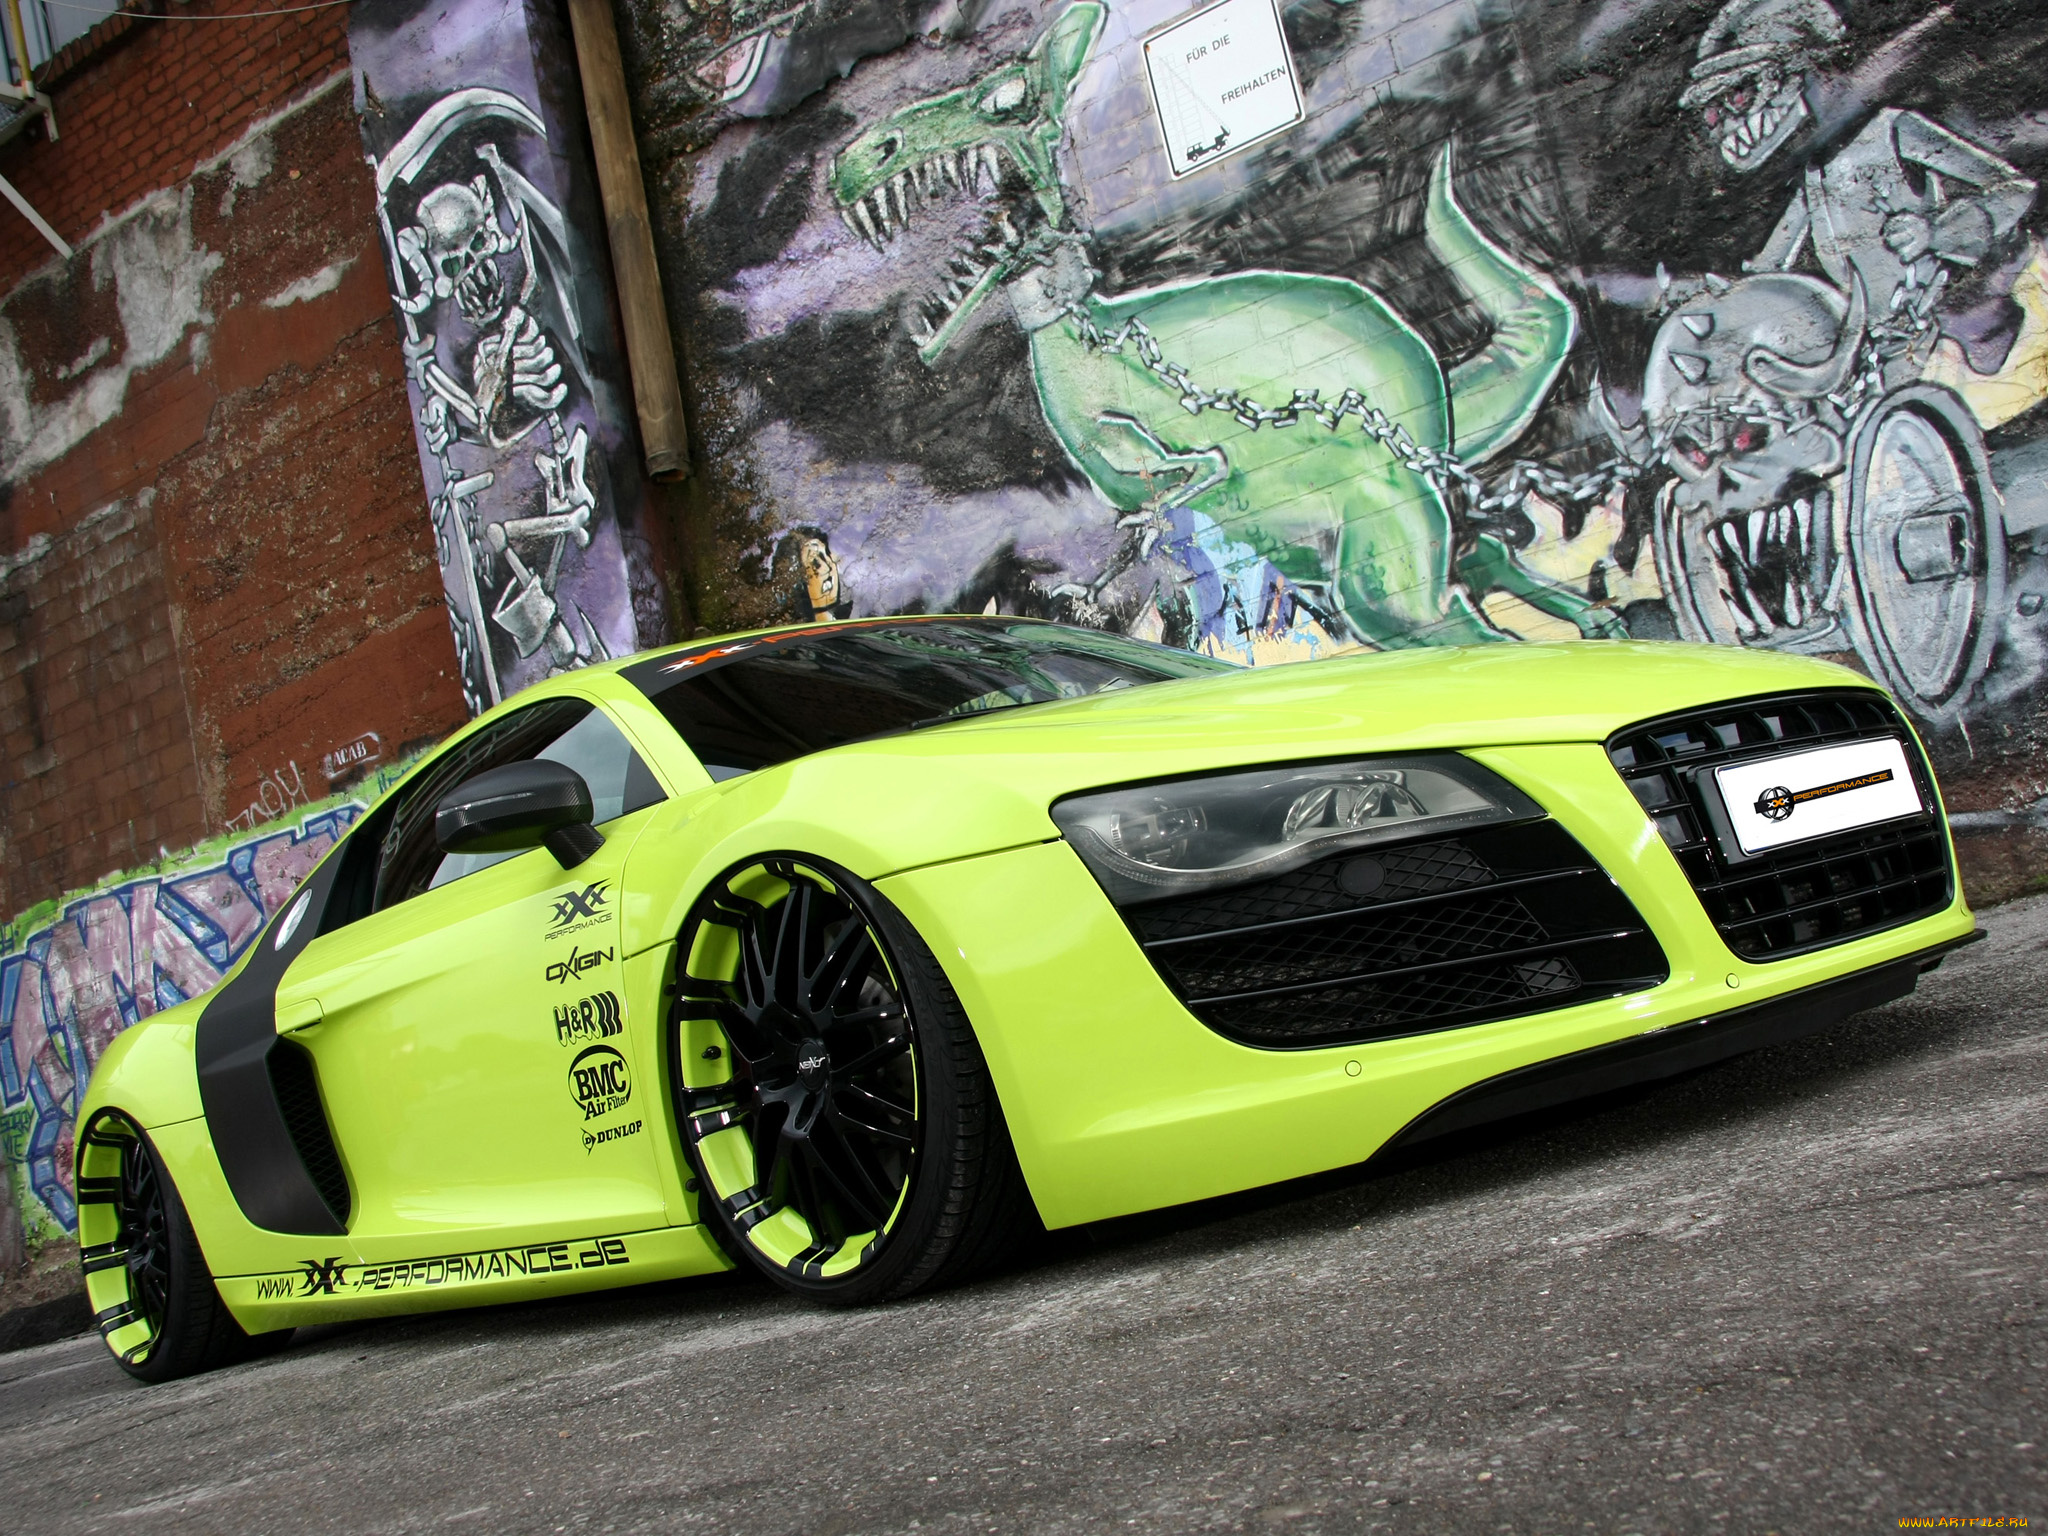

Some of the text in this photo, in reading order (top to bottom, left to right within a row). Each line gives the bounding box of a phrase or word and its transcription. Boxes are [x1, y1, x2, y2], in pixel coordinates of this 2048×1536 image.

[1186, 34, 1231, 64] FÜR DIE
[1221, 65, 1287, 104] FREIHALTEN
[332, 741, 367, 767] ACAB
[1793, 772, 1888, 802] PERFORMANCE
[544, 912, 612, 942] PERFORMANCE
[546, 946, 614, 984] OXIGIN
[553, 998, 600, 1047] H&R
[573, 1059, 627, 1101] BMC
[584, 1095, 628, 1121] Air Filter
[597, 1120, 642, 1144] DUNLOP
